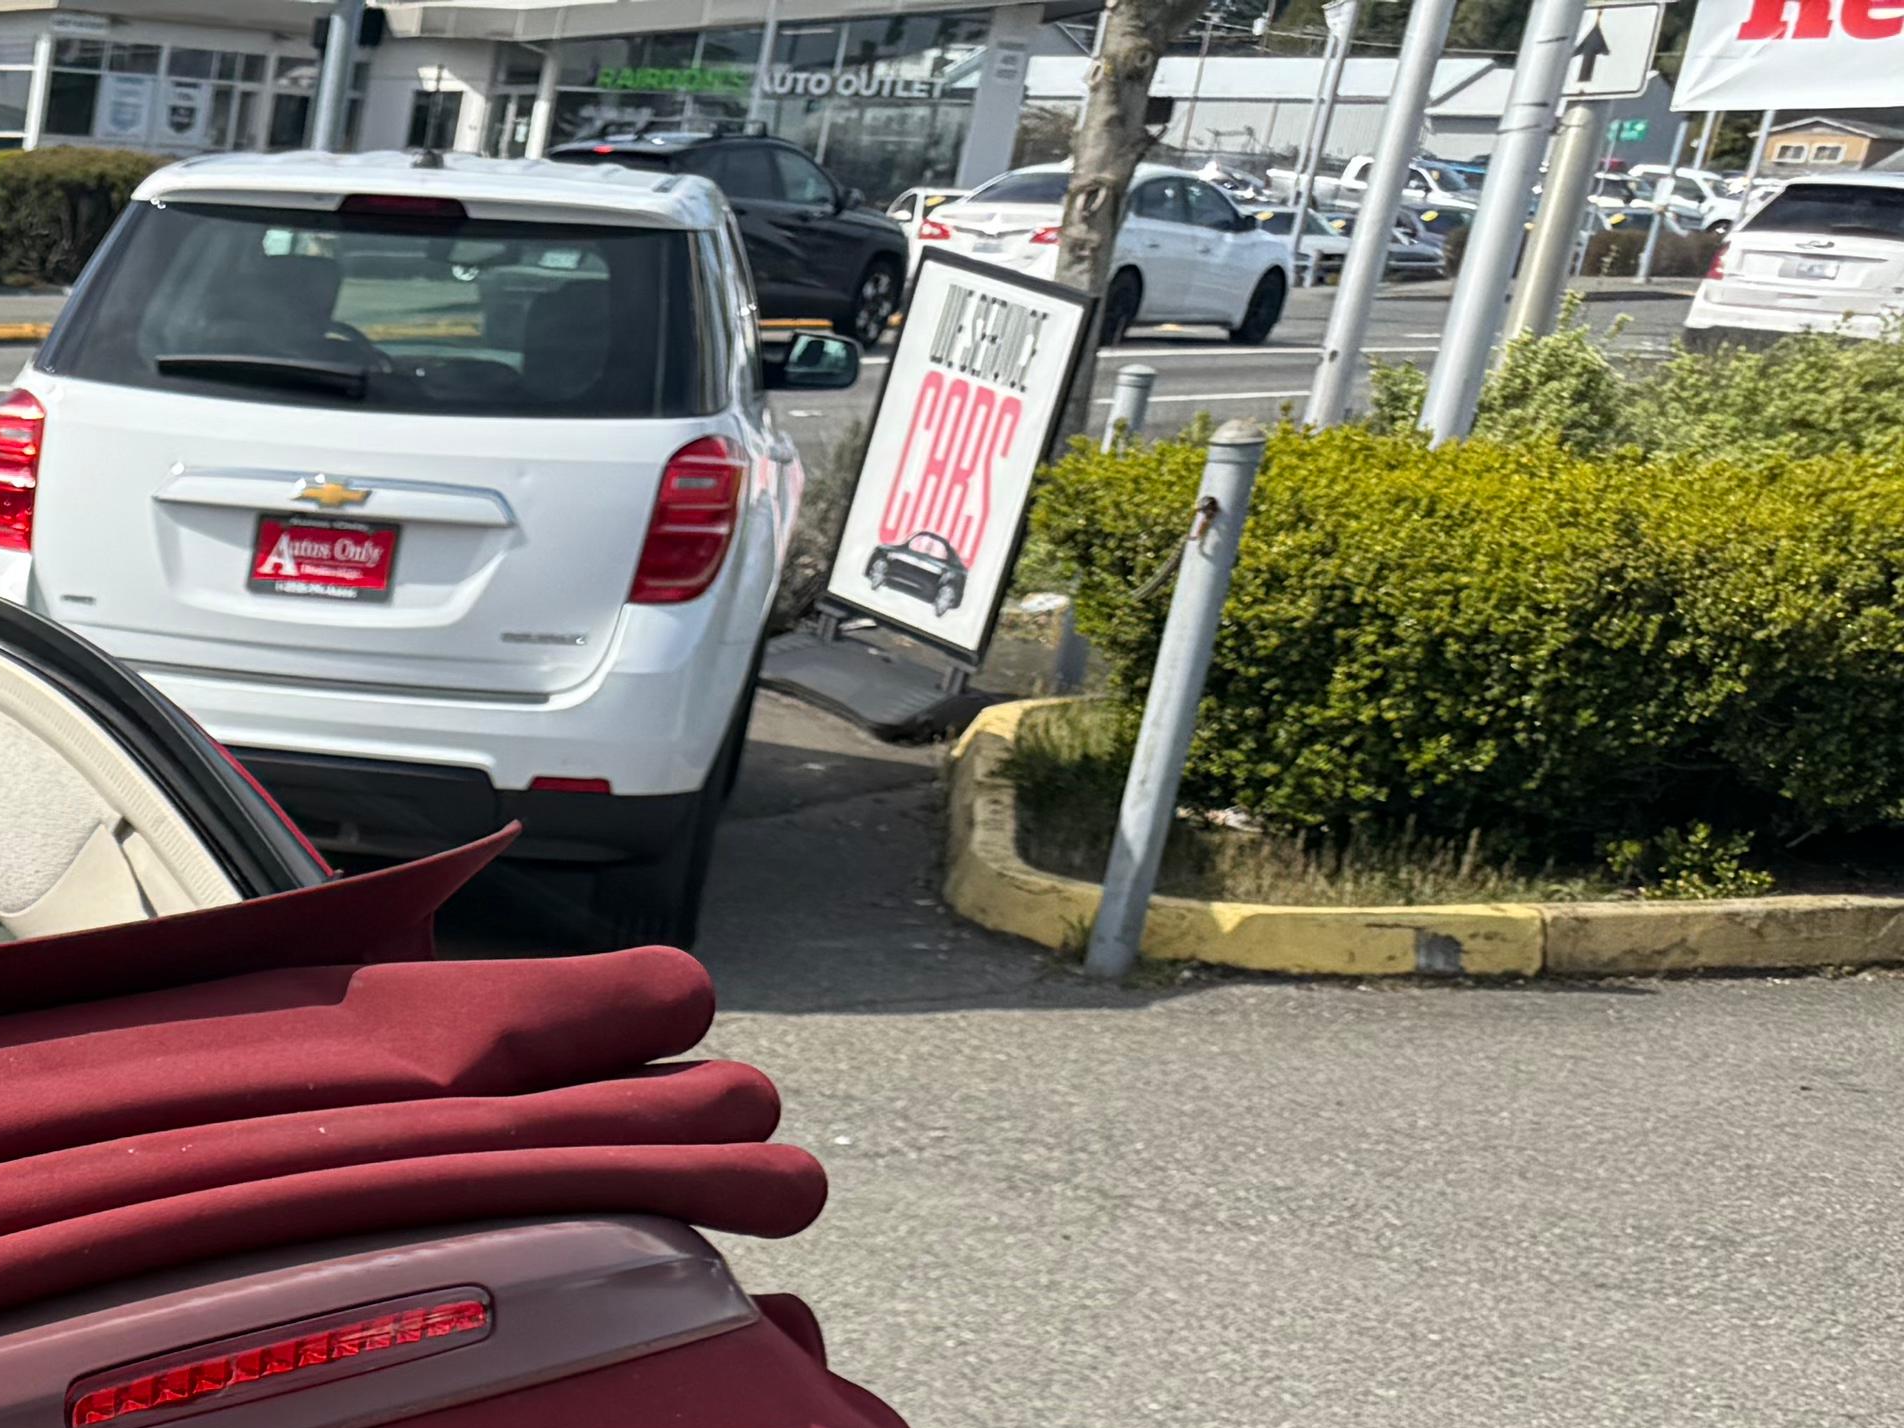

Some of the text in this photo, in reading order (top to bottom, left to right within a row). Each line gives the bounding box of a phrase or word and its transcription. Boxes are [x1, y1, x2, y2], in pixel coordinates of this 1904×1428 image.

[836, 72, 946, 99] OUTLET
[878, 370, 1023, 571] CARS
[256, 531, 331, 577] Autos
[333, 537, 383, 568] Only
